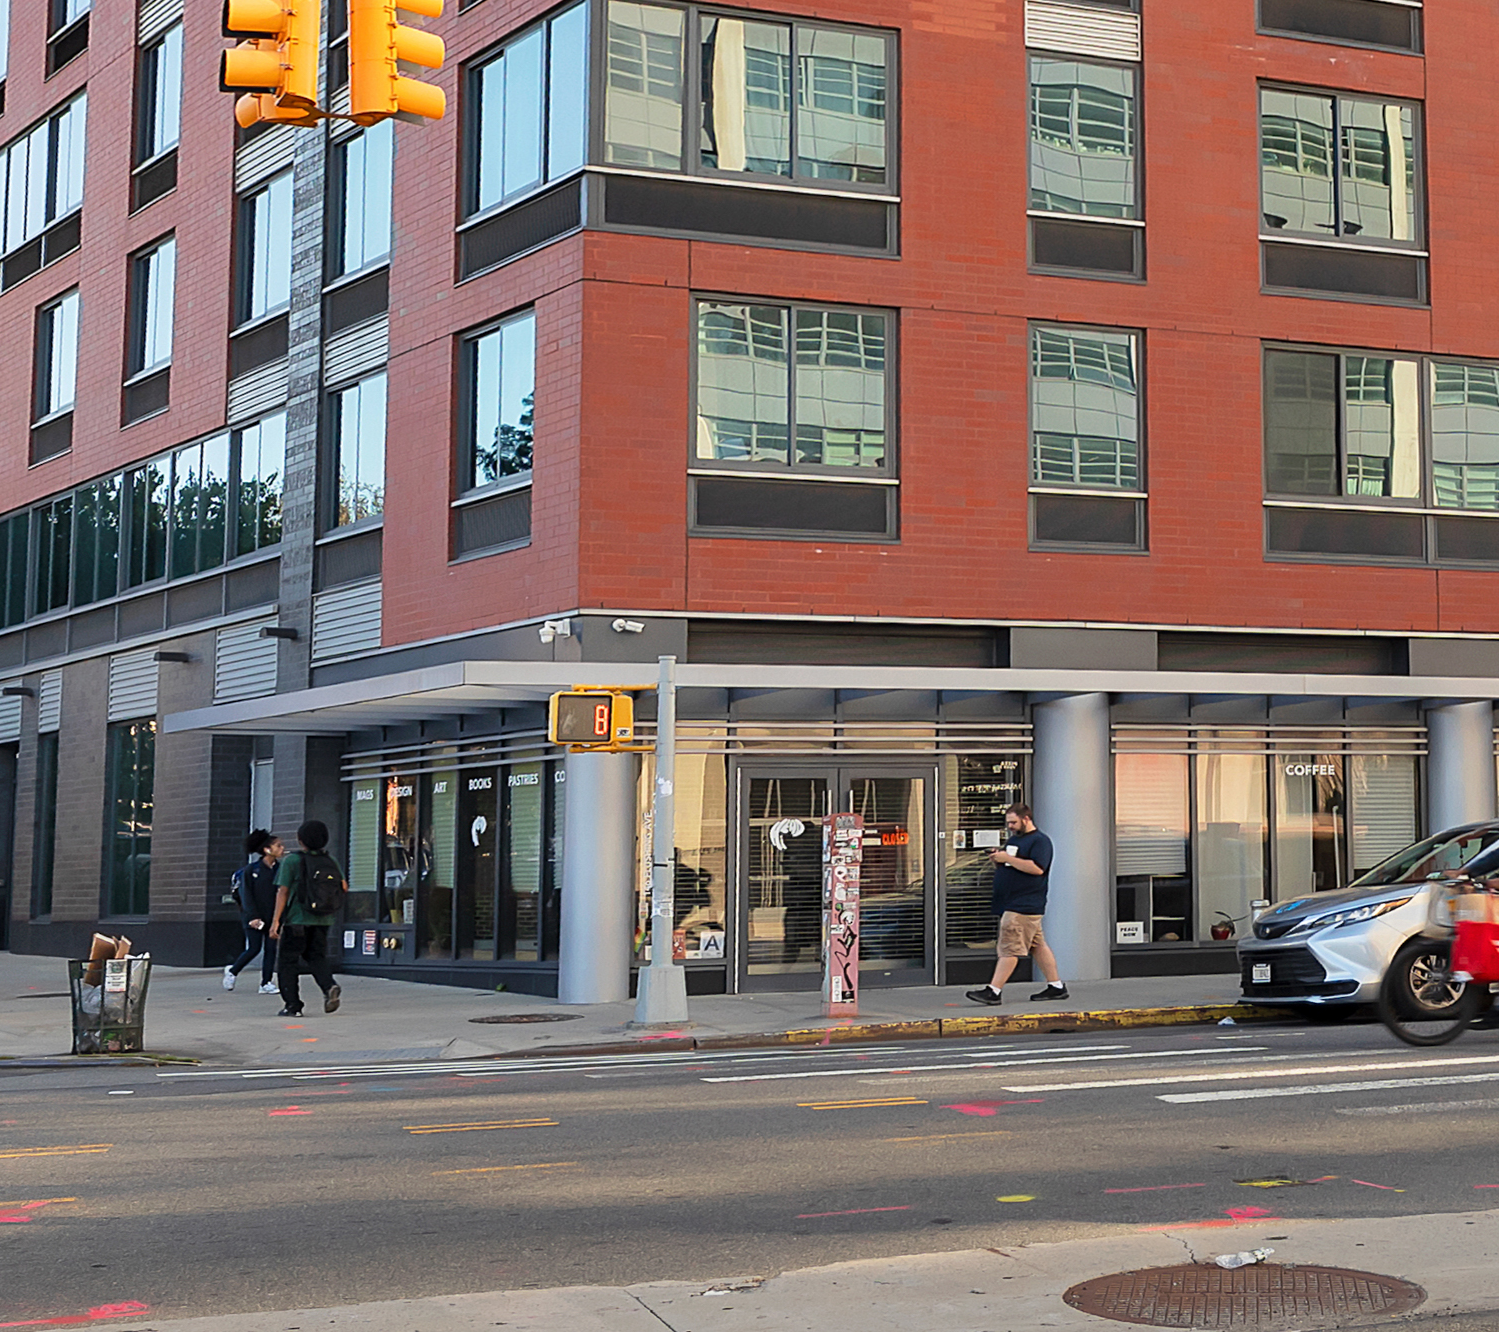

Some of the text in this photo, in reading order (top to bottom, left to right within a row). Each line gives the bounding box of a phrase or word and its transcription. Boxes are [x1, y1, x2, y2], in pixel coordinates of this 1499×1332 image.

[594, 704, 609, 735] 8
[1285, 764, 1335, 776] COFFEE
[468, 777, 492, 791] BOOKS
[508, 773, 539, 787] PASTRIES
[390, 785, 413, 797] DESIGN
[434, 781, 447, 794] ART
[356, 789, 374, 801] MAGS
[704, 935, 720, 950] A
